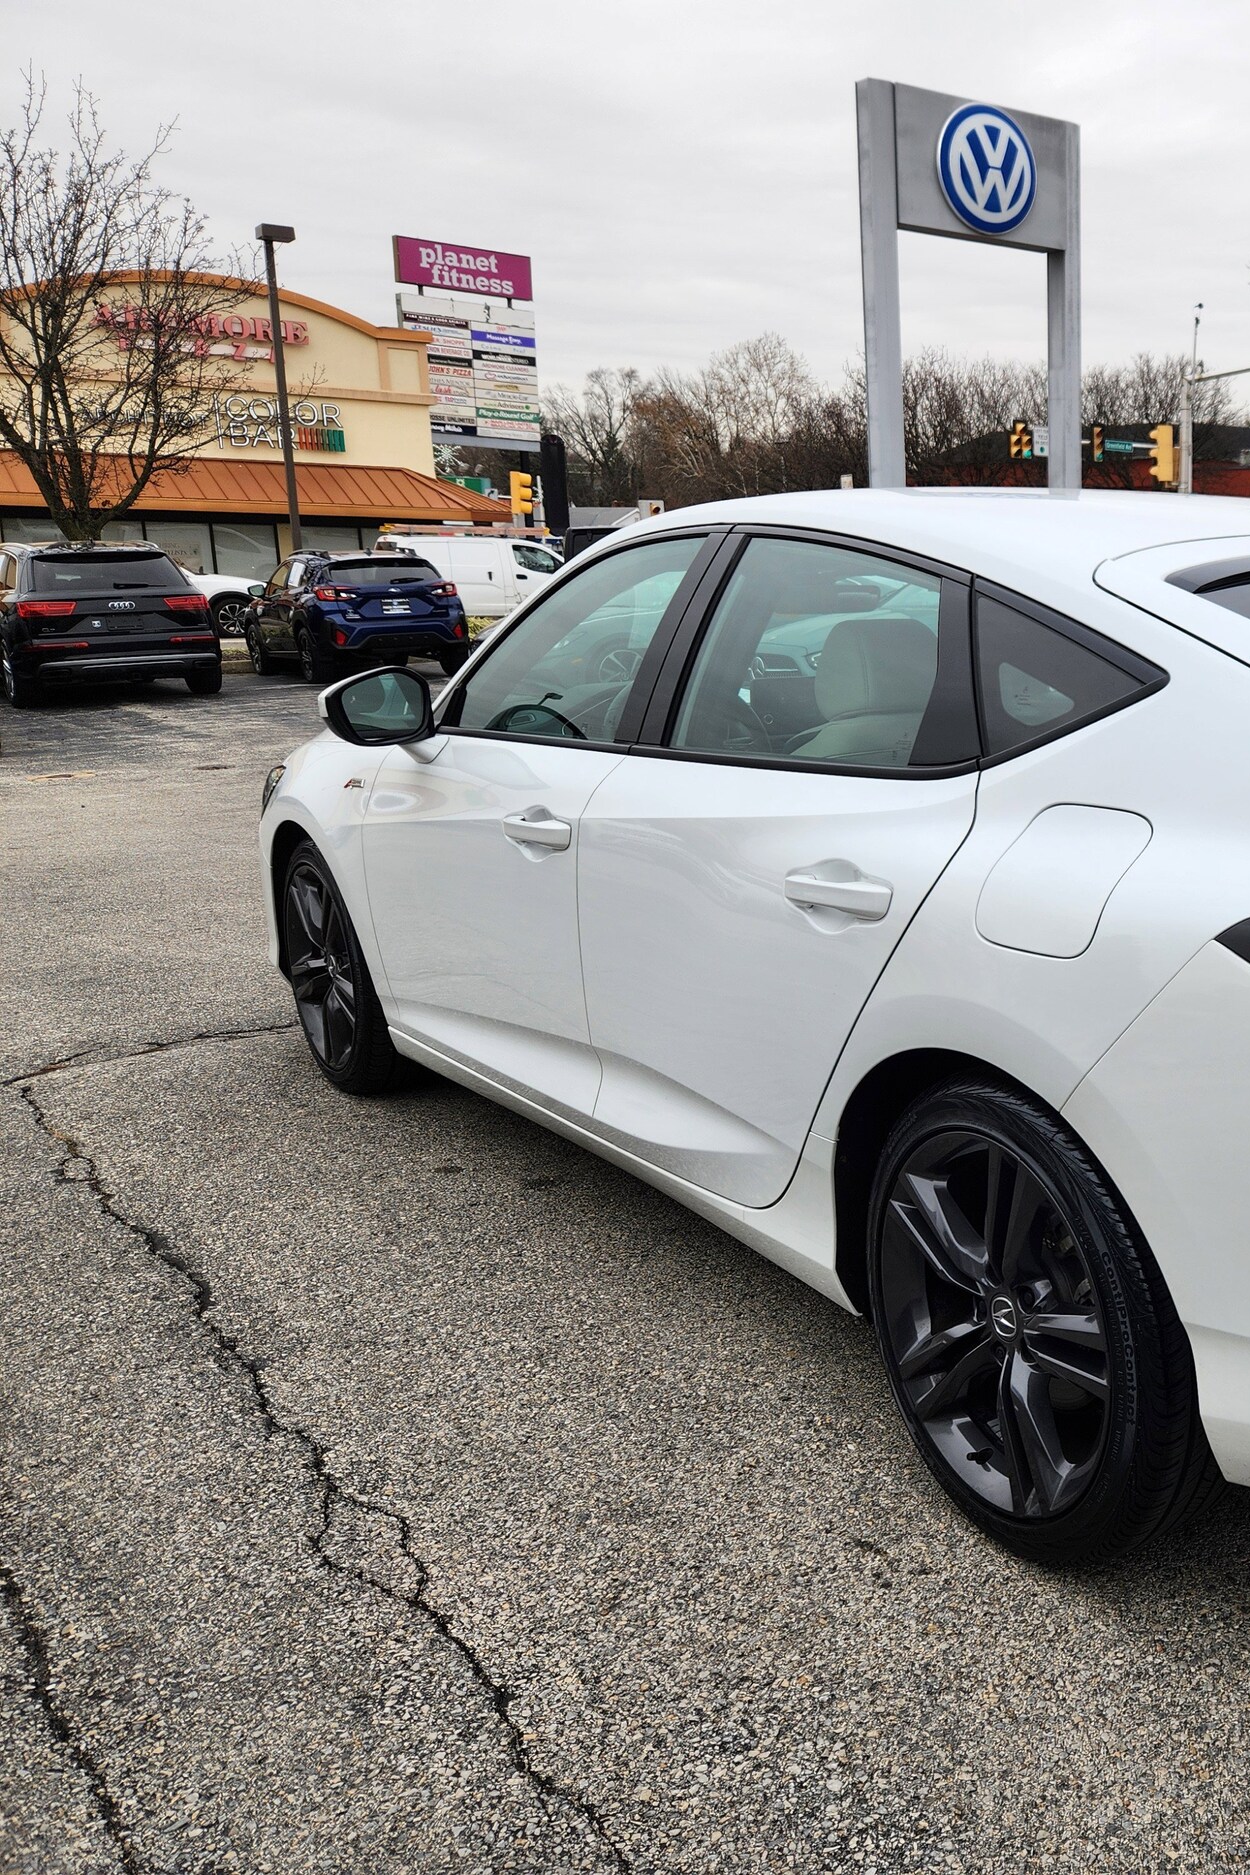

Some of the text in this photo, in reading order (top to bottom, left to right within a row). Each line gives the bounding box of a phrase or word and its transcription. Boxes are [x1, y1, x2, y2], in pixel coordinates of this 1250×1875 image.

[948, 112, 1031, 223] VW
[419, 244, 498, 273] planet
[431, 264, 514, 295] fitness
[452, 368, 472, 377] PIZZA
[226, 396, 344, 428] COLOR
[229, 422, 299, 450] BAR
